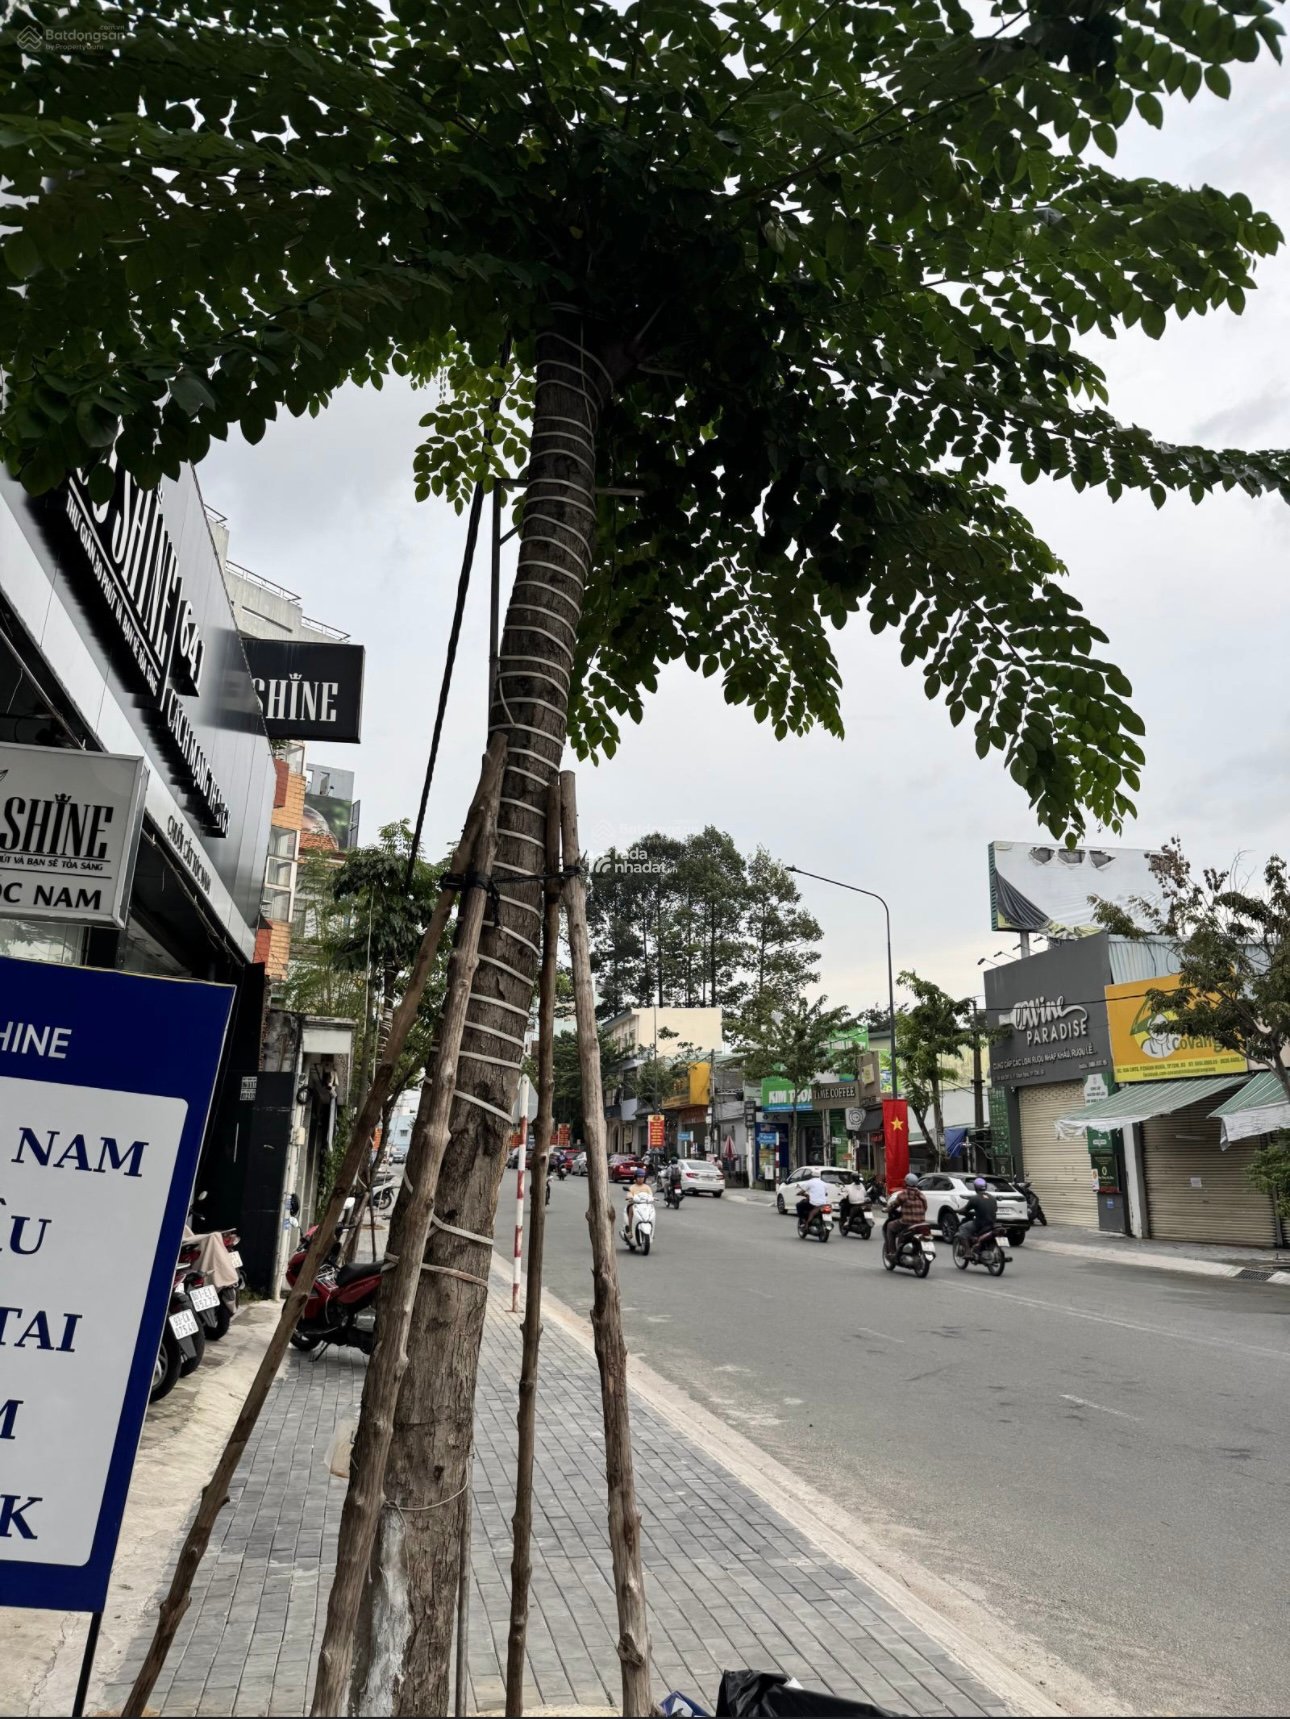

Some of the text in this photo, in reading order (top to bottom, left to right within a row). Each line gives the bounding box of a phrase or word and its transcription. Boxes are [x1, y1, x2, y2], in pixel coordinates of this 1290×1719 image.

[180, 600, 207, 692] 641
[167, 688, 192, 760] CÁCH
[0, 796, 114, 859] SHINE
[14, 856, 24, 865] VÀ
[27, 858, 45, 867] BẠN
[81, 861, 103, 871] SÁNG
[33, 884, 102, 911] NAM
[1026, 1020, 1087, 1046] PARADISE
[768, 1090, 787, 1104] KIM
[830, 1086, 856, 1098] COFFEE
[11, 1126, 149, 1178] NAM
[0, 1306, 83, 1353] TAI
